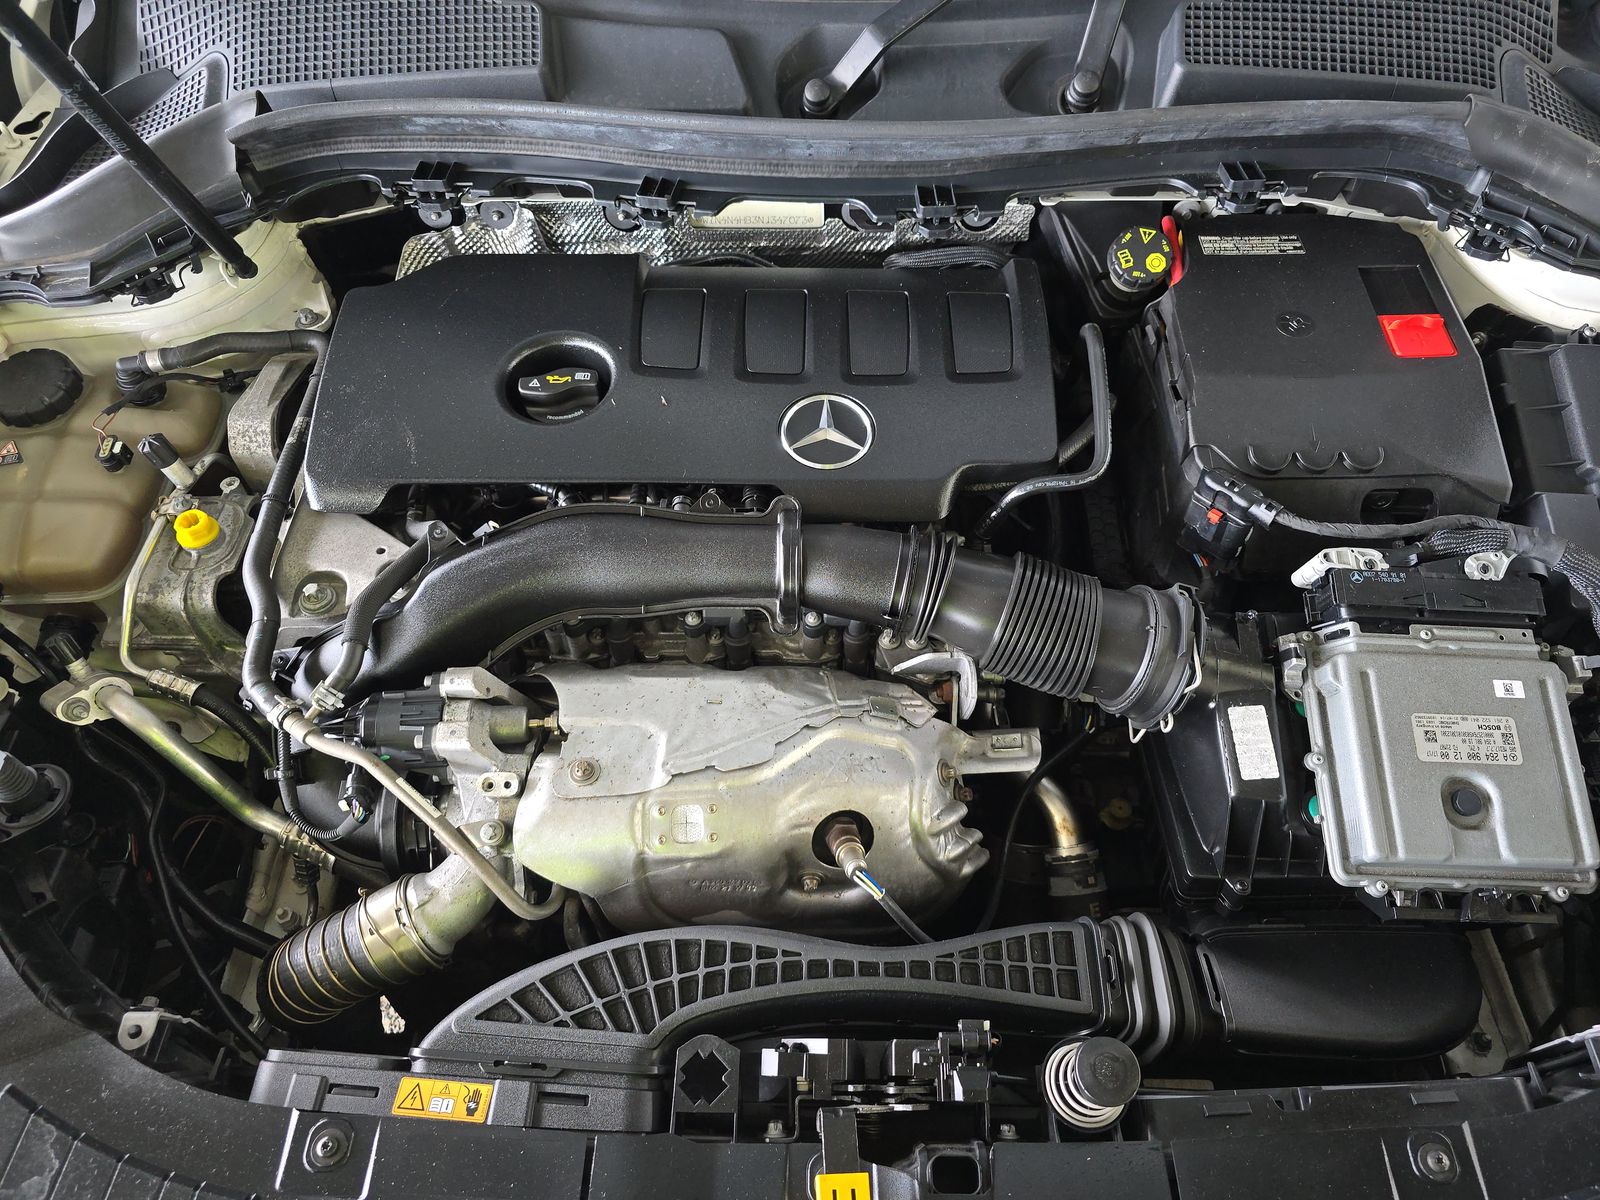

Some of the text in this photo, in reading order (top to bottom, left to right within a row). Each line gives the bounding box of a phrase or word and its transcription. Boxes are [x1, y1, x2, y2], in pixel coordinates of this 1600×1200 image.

[1440, 751, 1450, 760] 00
[1453, 752, 1463, 760] 12
[1467, 752, 1482, 761] 900
[1485, 753, 1500, 761] 264
